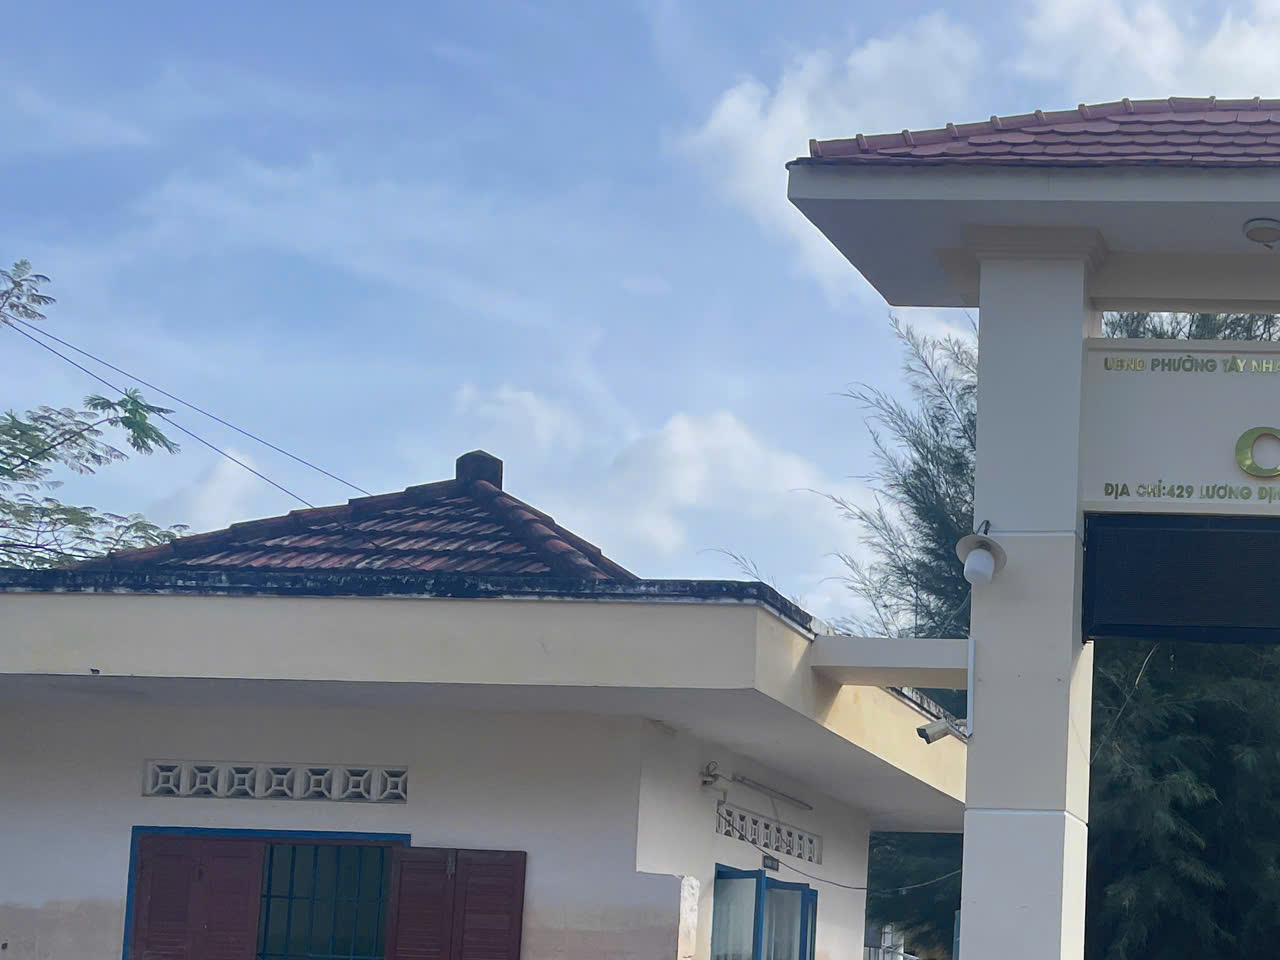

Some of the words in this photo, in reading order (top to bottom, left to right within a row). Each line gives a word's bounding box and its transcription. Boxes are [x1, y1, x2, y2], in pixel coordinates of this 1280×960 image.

[1103, 357, 1147, 372] UBND
[1151, 355, 1217, 372] PHƯỜNG
[1222, 355, 1246, 372] TÂY
[1104, 483, 1130, 500] ĐỊA
[1200, 484, 1252, 501] LƯƠNG
